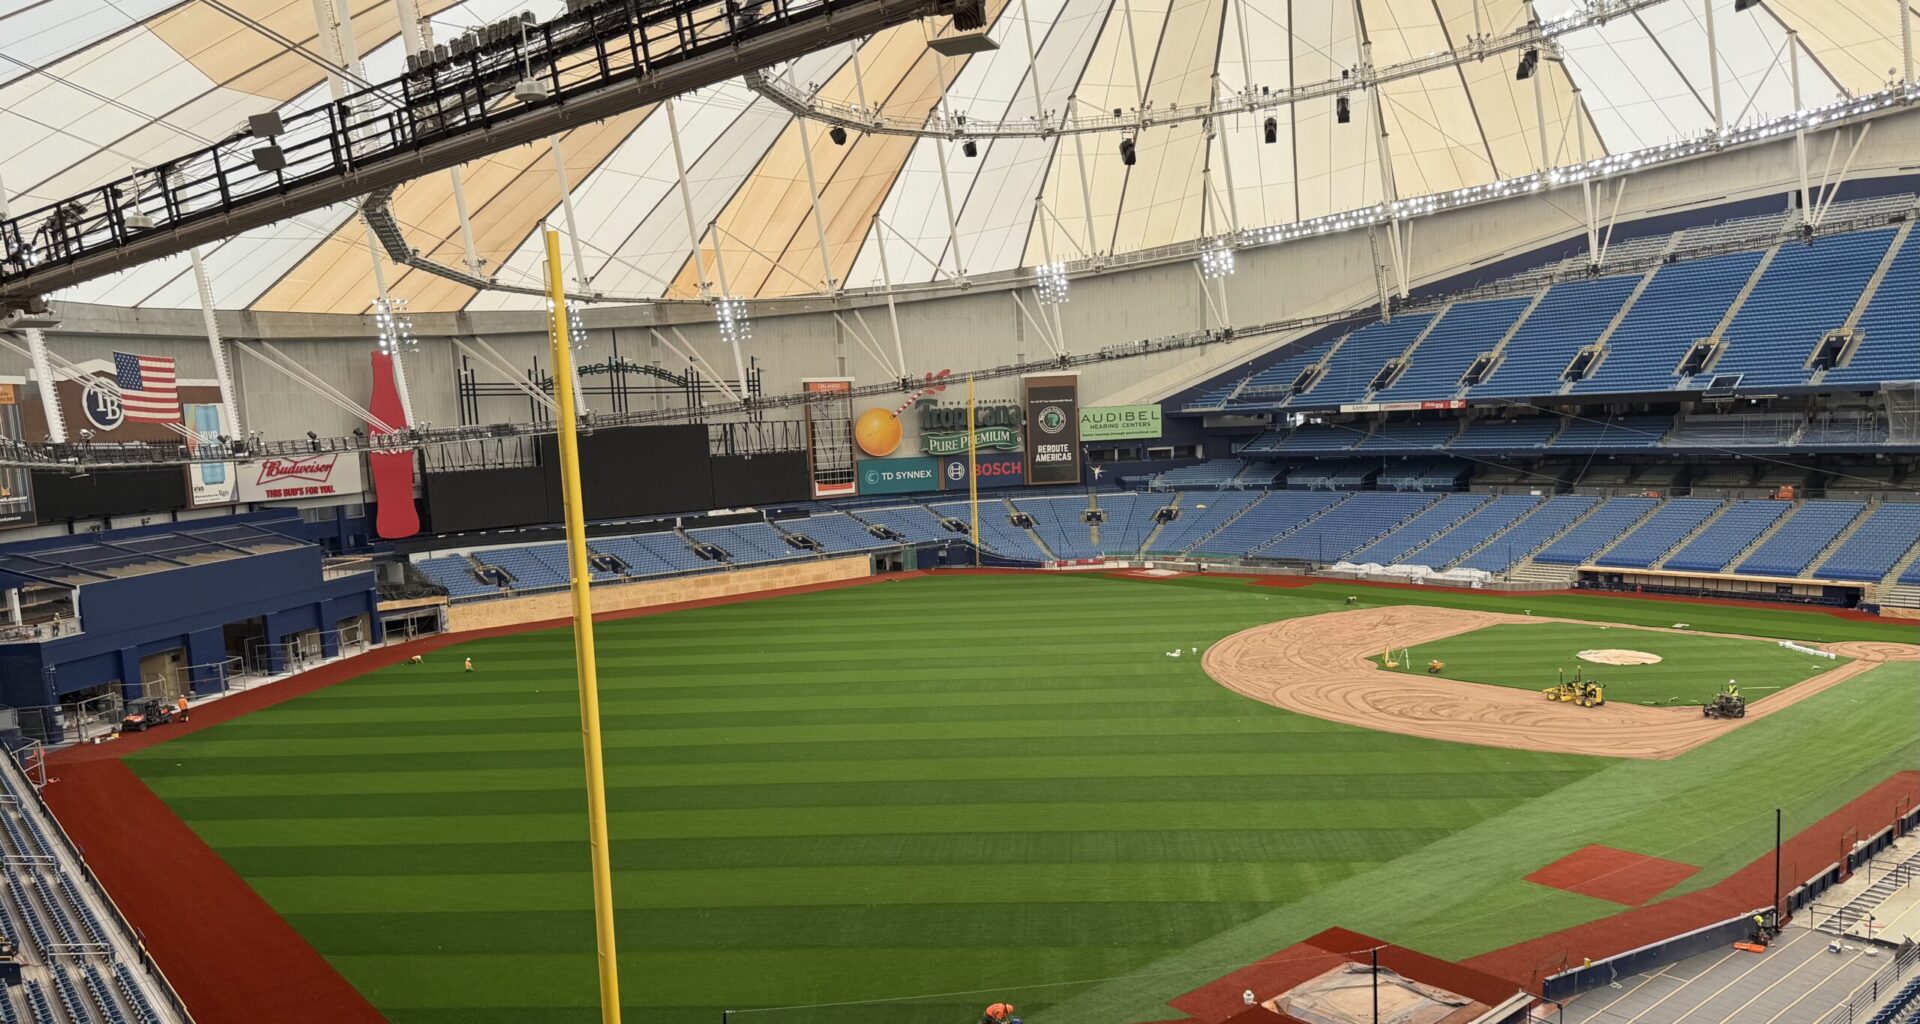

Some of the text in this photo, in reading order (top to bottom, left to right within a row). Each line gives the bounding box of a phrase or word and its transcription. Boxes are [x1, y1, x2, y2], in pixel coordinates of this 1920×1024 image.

[914, 398, 1022, 432] Tropcana
[1080, 410, 1160, 424] AUDIBEL
[1090, 421, 1151, 430] HEARING CENTERS
[929, 438, 959, 452] PURE
[1037, 443, 1070, 454] REROUTE
[1035, 452, 1072, 463] AMERICAS
[262, 460, 334, 478] Budweiser
[881, 469, 933, 480] TD SYNNEX
[265, 488, 282, 498] THIS
[283, 487, 304, 498] BUD'S
[305, 486, 319, 496] FOR
